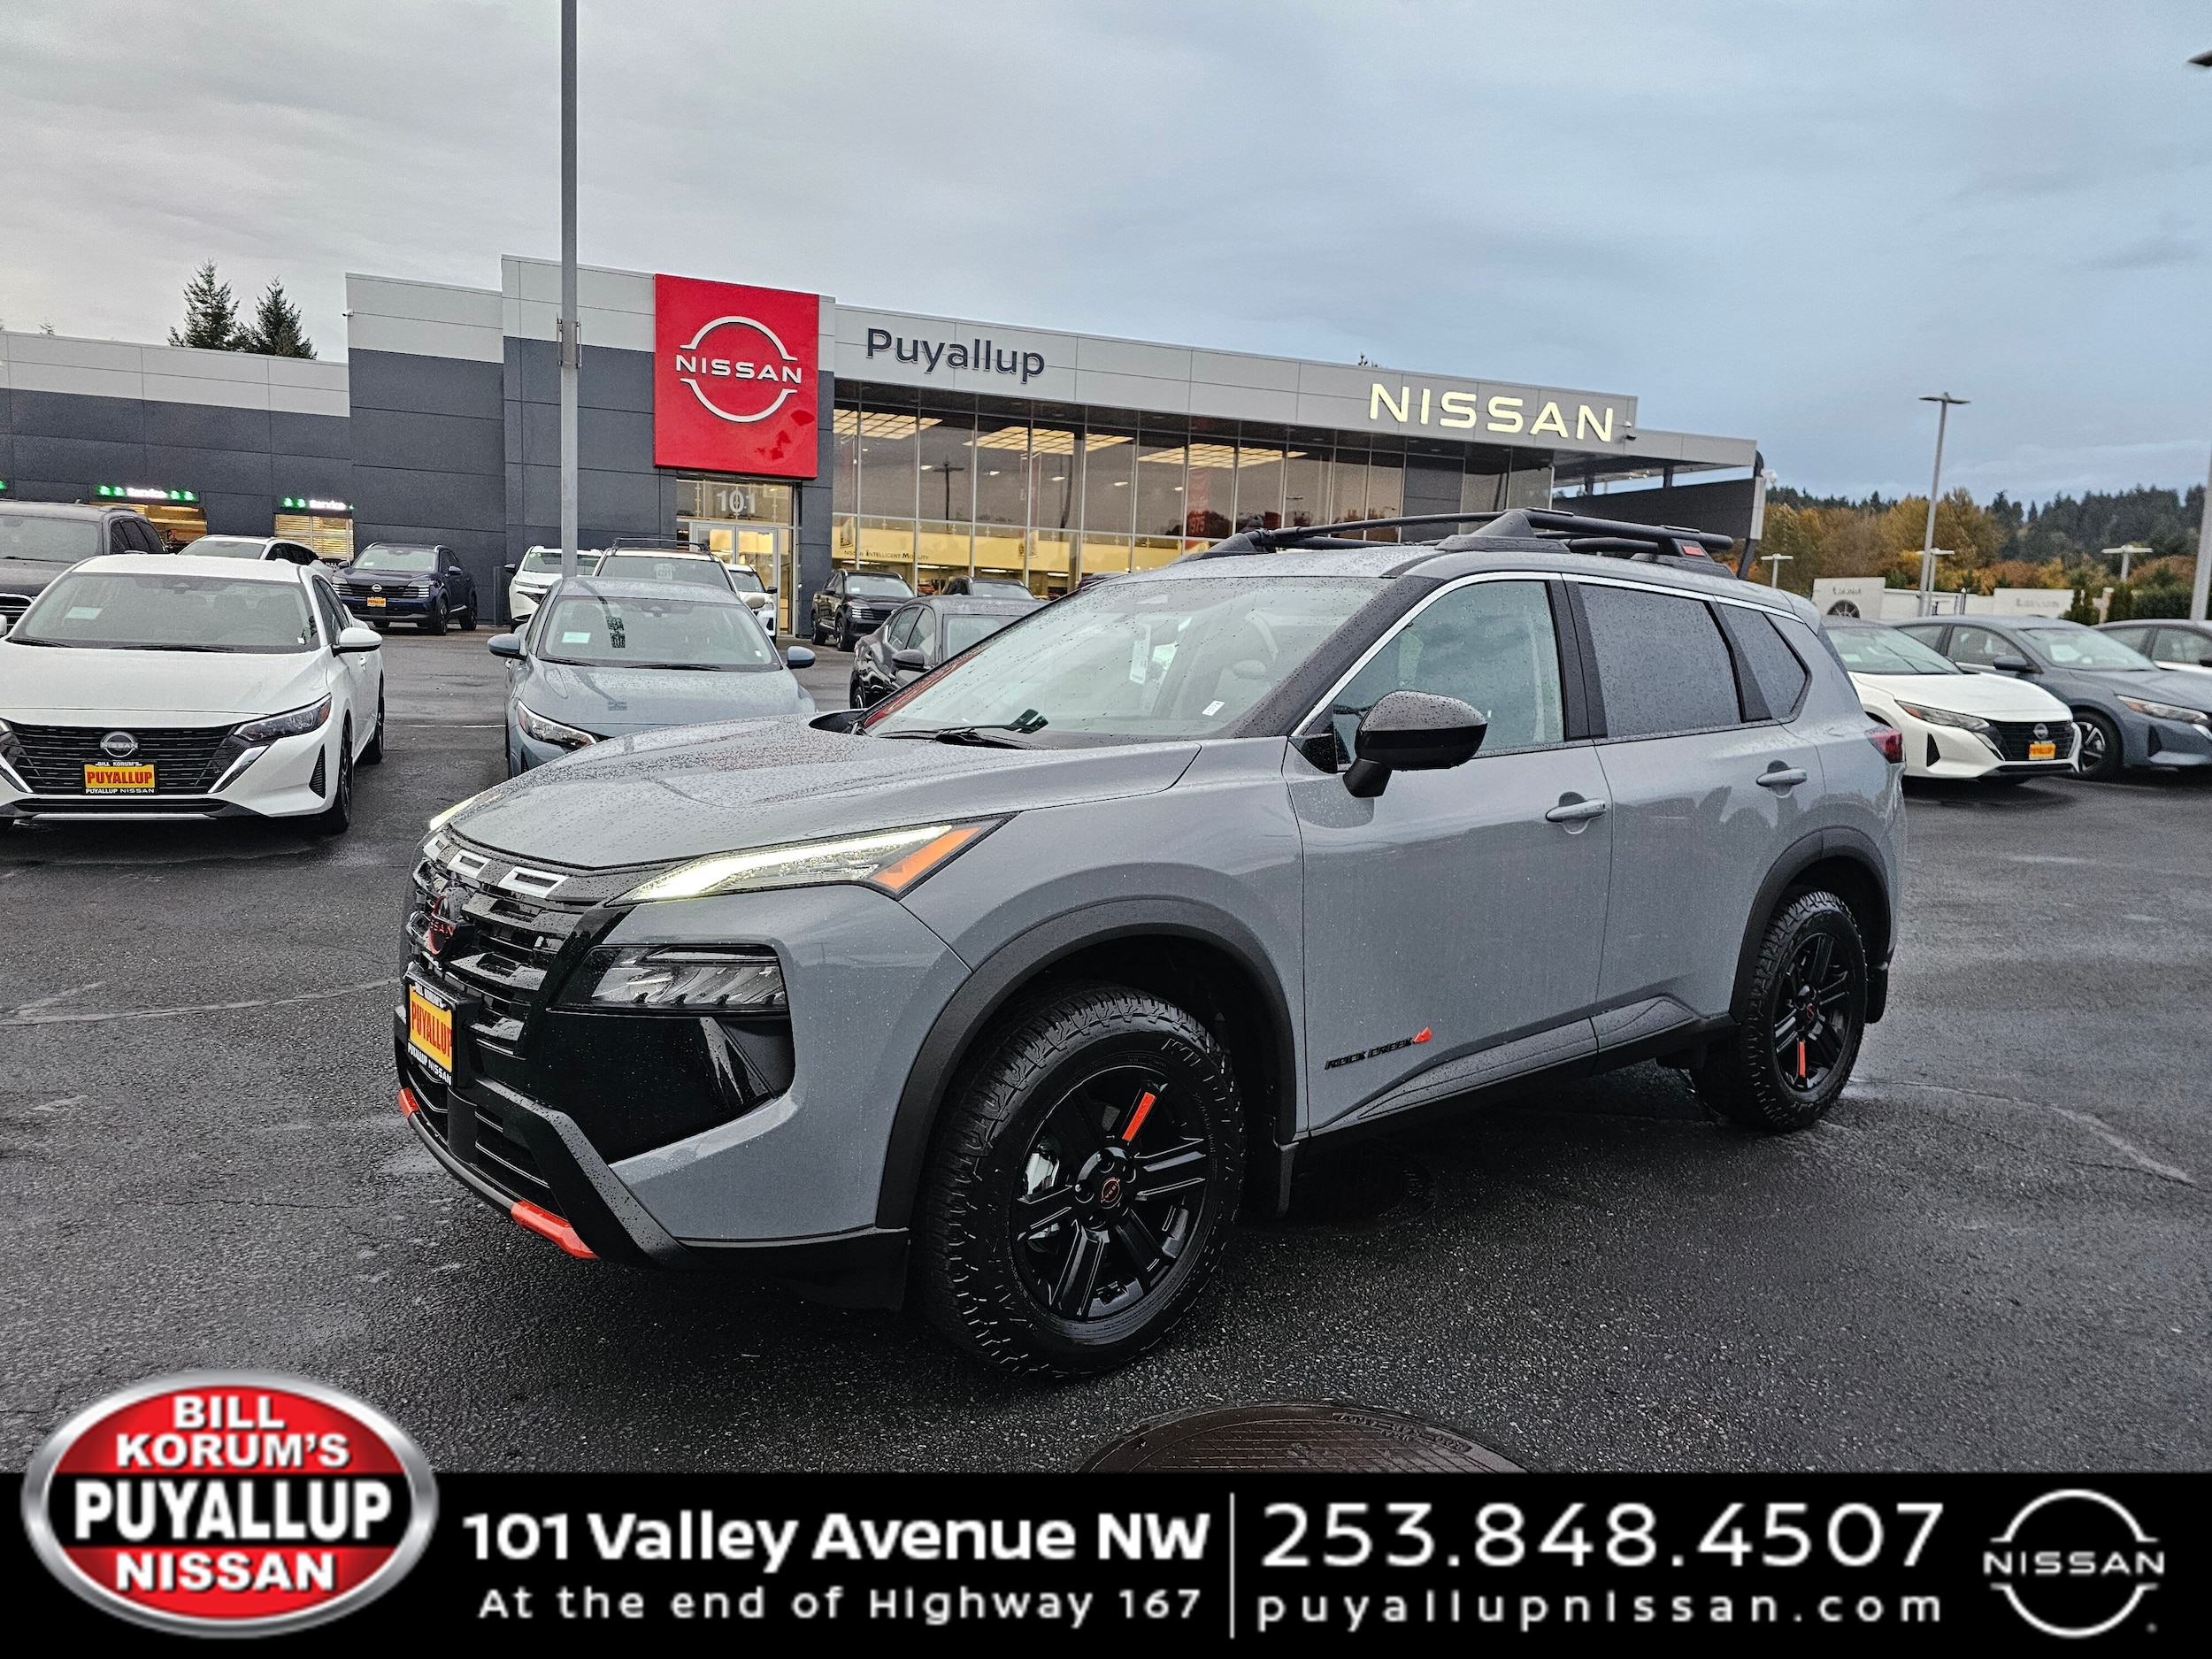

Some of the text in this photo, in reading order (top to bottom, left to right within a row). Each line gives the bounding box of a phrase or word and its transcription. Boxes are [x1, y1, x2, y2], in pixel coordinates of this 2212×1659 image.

[676, 354, 802, 384] NISSAN
[866, 327, 1045, 384] Puyallup
[1370, 383, 1613, 442] NISSAN
[717, 490, 756, 514] 101
[100, 741, 138, 750] NISSAN
[86, 771, 153, 784] PUYALLUP
[411, 1000, 452, 1058] PUYALLUP
[1325, 1037, 1413, 1070] ROCK CREEK
